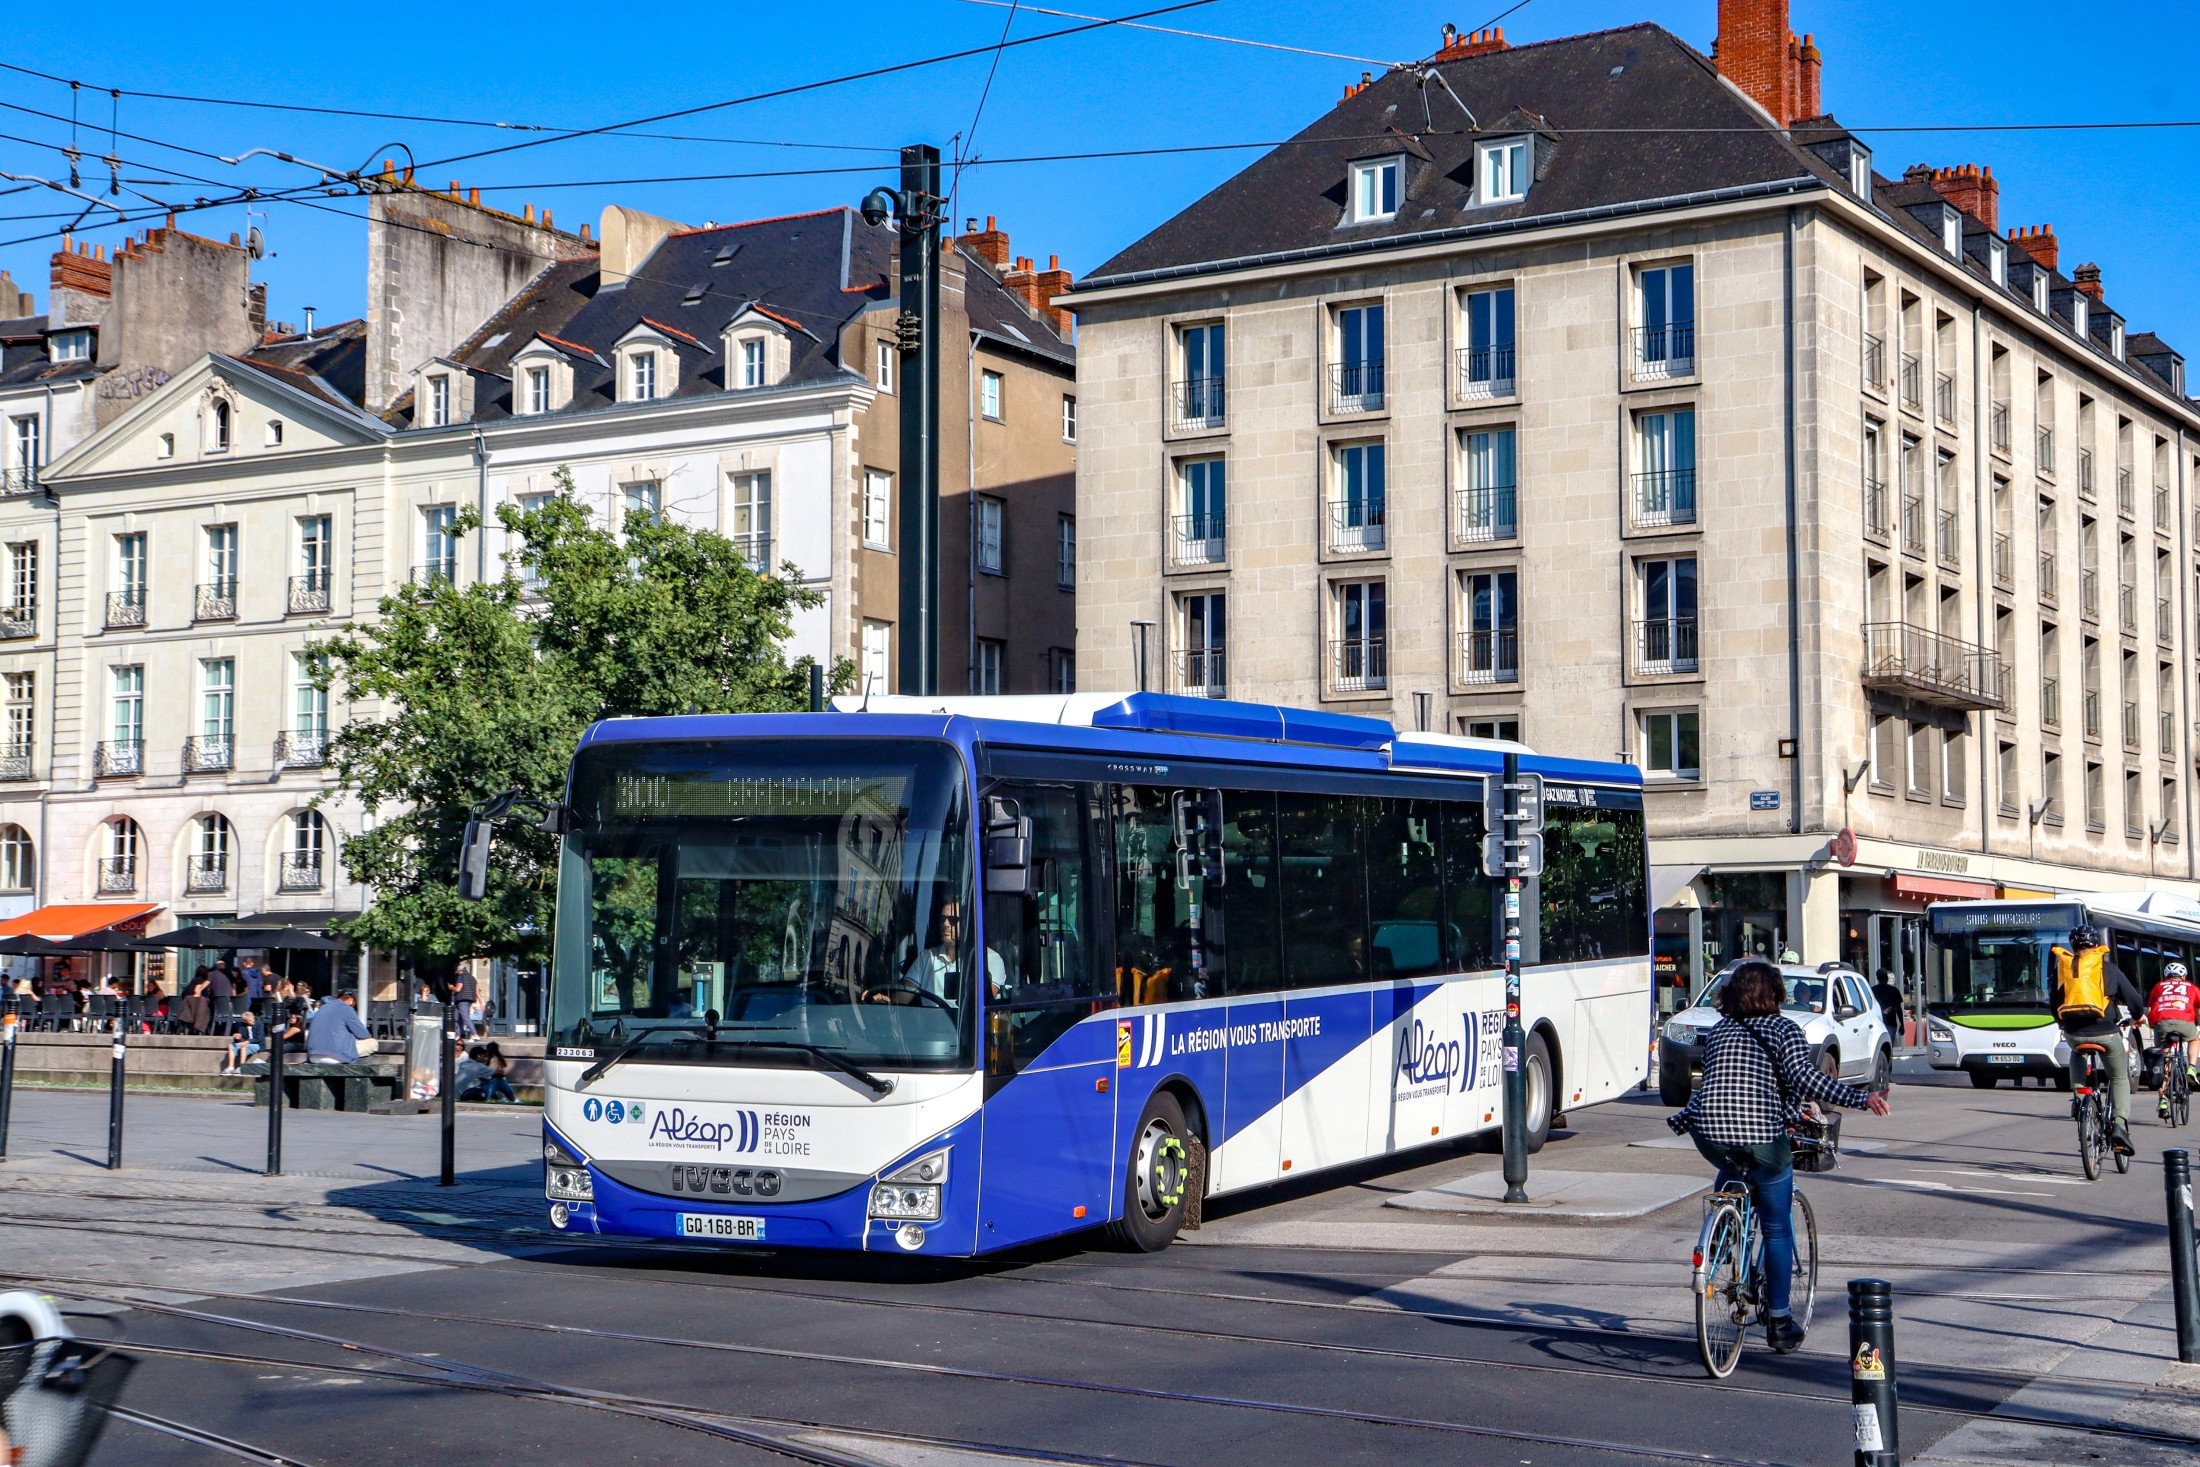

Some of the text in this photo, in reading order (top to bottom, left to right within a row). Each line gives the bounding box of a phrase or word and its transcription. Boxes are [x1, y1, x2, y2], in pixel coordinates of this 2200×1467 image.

[1546, 788, 1556, 801] GAZ
[1556, 788, 1578, 802] NATUREL
[2162, 985, 2187, 996] 24
[1171, 1016, 1320, 1055] LA RÉGION VOUS TRANSPORTE
[1393, 1019, 1460, 1096] Aléop
[1481, 1066, 1486, 1076] DE
[1480, 1079, 1485, 1088] LA
[1398, 1092, 1411, 1102] RÉGION
[1413, 1090, 1422, 1099] VOUS
[1423, 1085, 1445, 1096] TRANSPORTE
[764, 1112, 810, 1127] RÉGION
[649, 1108, 734, 1151] Aléop
[764, 1128, 795, 1140] PAYS
[776, 1142, 810, 1155] LOIRE
[672, 1165, 781, 1196] IVECO
[686, 1218, 754, 1236] GQ-168-BR
